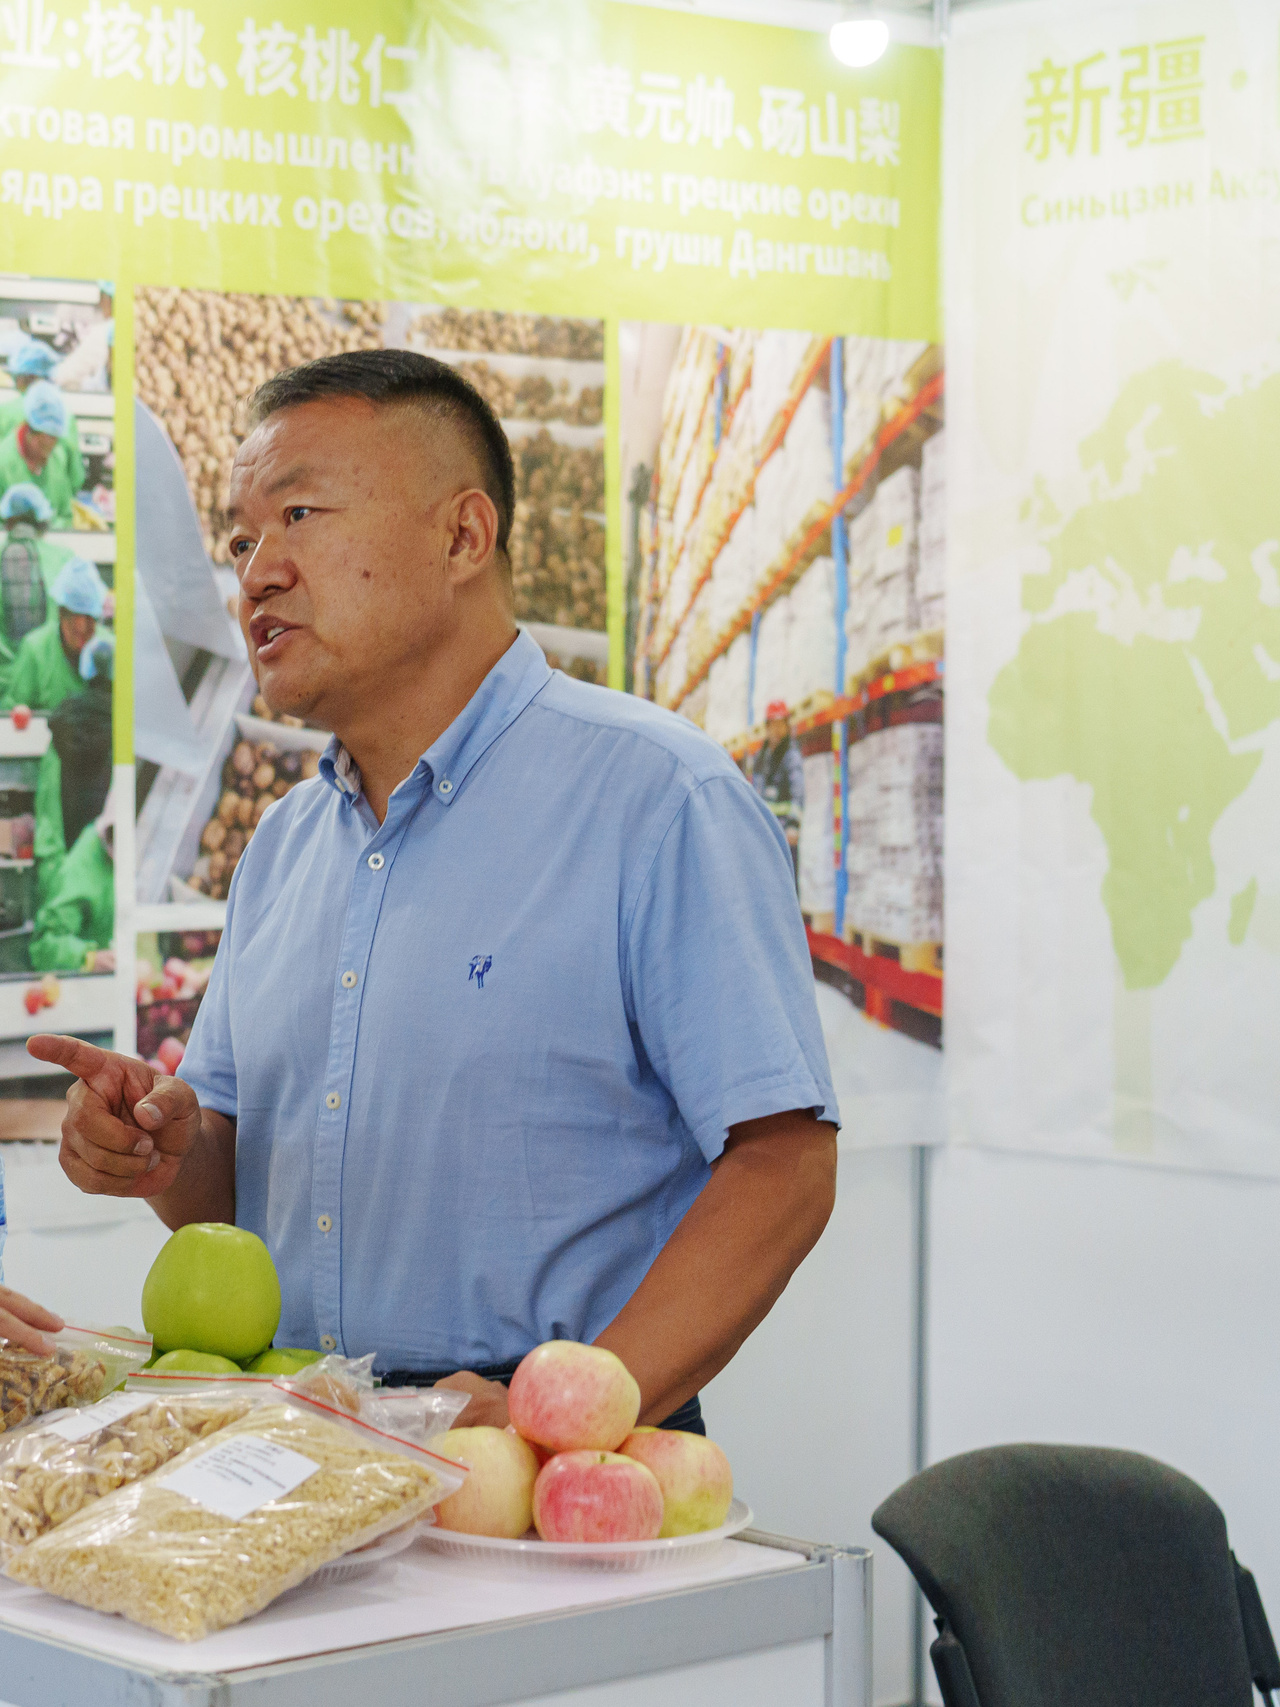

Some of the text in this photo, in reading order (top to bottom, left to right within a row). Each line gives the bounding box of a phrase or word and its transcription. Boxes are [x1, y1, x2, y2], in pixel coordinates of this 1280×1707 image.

[1025, 34, 1280, 162] 新疆·
[0, 168, 103, 221] ядра
[113, 177, 284, 232] грецких
[456, 197, 601, 266] яблоки,
[614, 223, 723, 274] груши
[729, 228, 892, 283] Дангшань
[145, 117, 508, 186] промышленность
[661, 173, 802, 222] грецкие
[808, 187, 901, 230] орехи
[1021, 181, 1194, 228] Синьцзян
